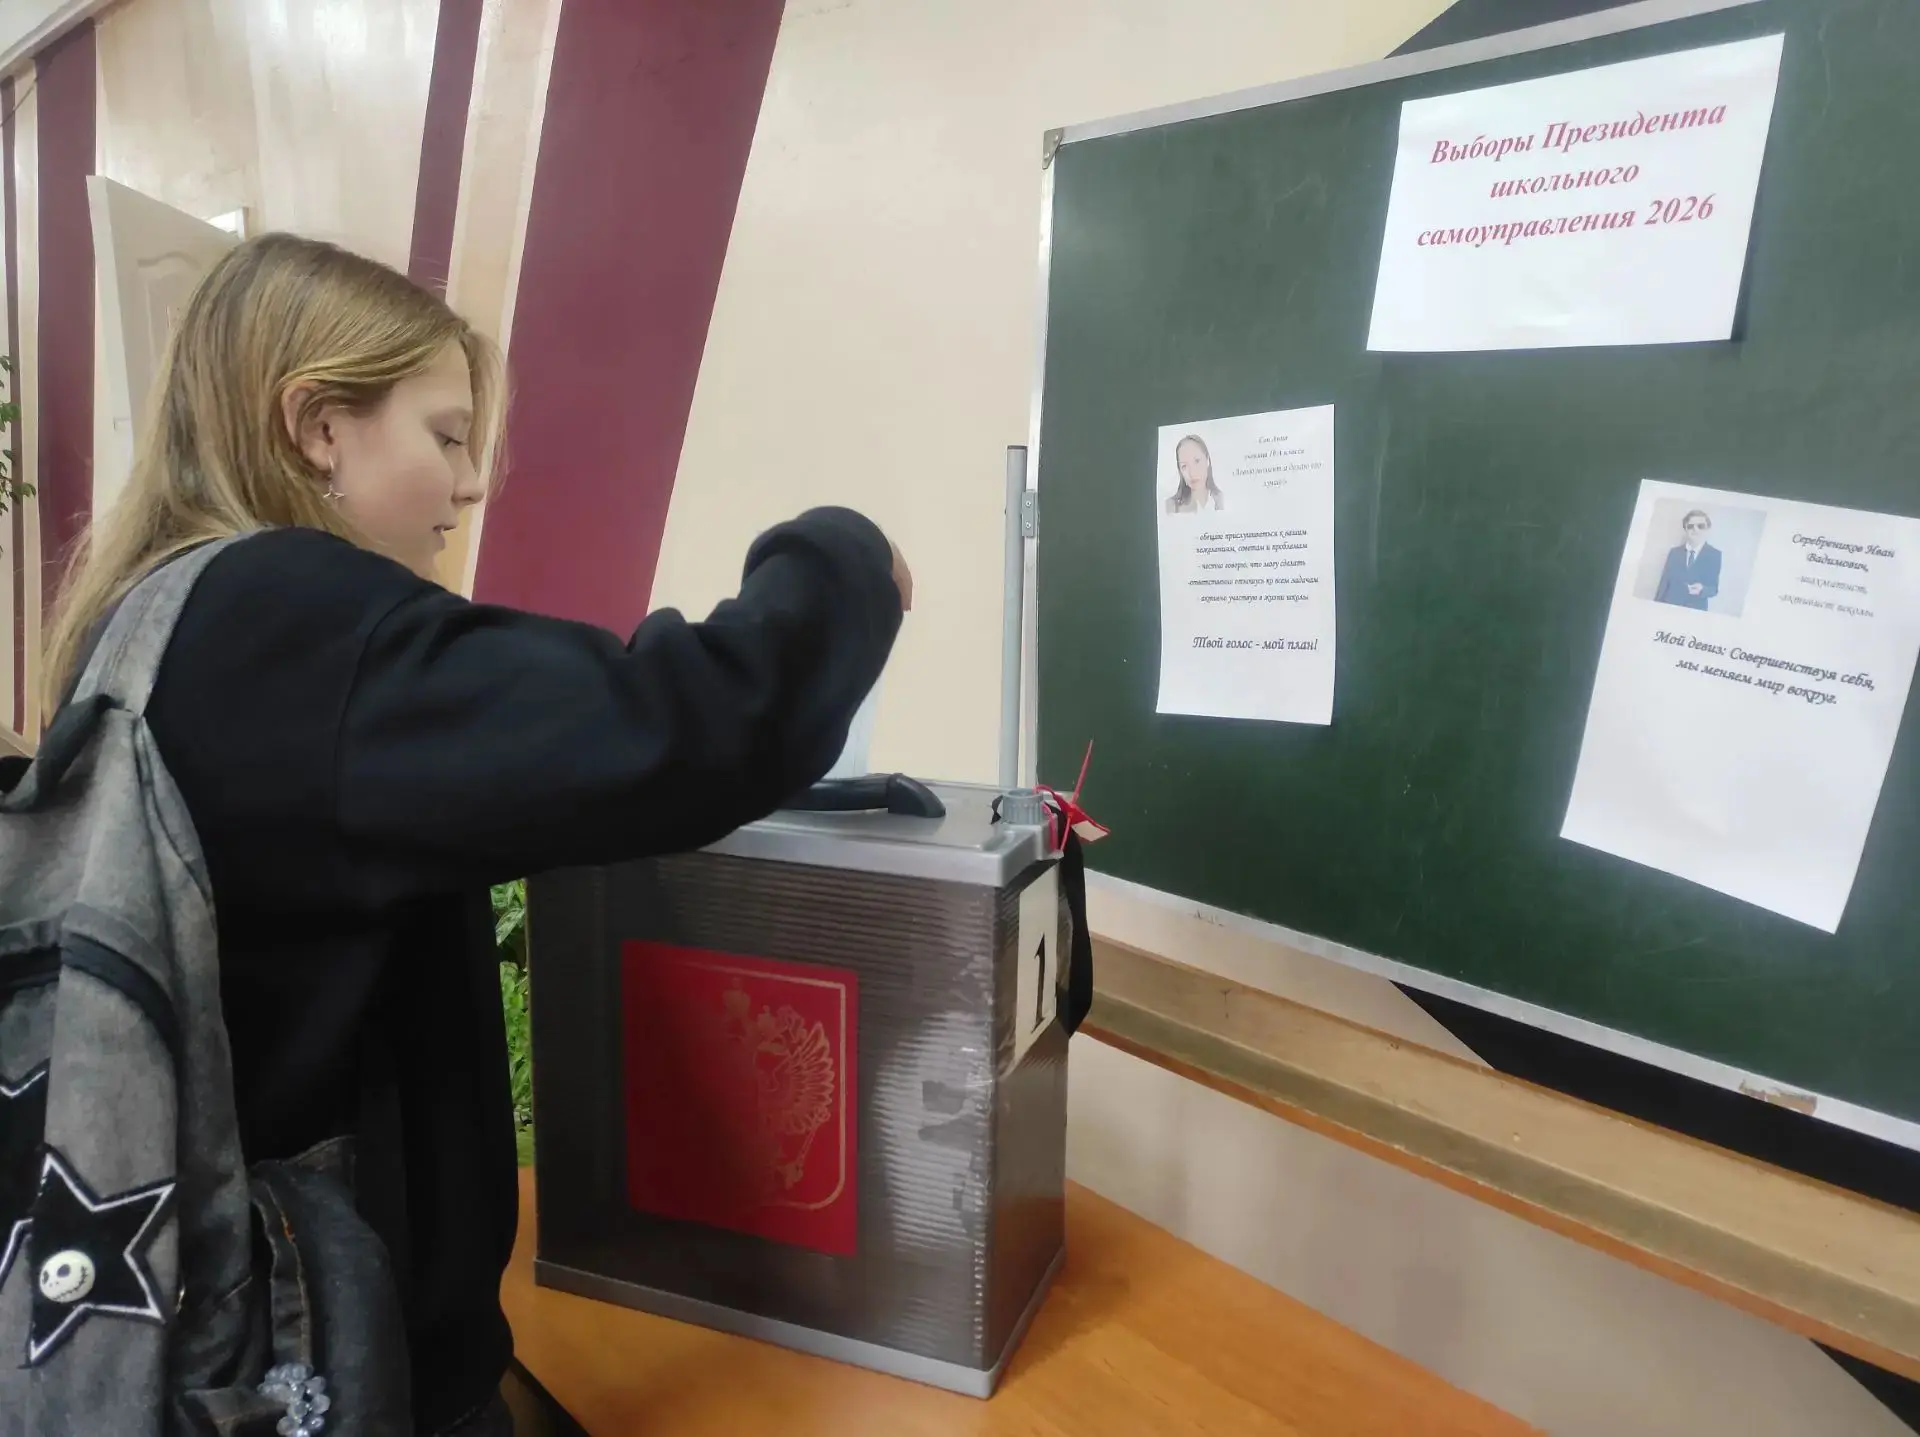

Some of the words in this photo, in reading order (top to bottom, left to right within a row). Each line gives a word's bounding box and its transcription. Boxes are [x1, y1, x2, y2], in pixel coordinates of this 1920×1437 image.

[1430, 135, 1534, 163] Выборы
[1542, 104, 1727, 153] Президента
[1490, 164, 1640, 198] школьного
[1417, 207, 1636, 248] самоуправления
[1644, 193, 1717, 226] 2026
[1200, 532, 1223, 540] обещаю
[1272, 541, 1307, 552] проблемам
[1792, 533, 1863, 554] Серебреников
[1865, 544, 1895, 558] Иван
[1263, 561, 1279, 570] могу
[1192, 636, 1223, 649] Твой
[1225, 639, 1253, 649] голос
[1262, 637, 1284, 650] мой
[1287, 638, 1319, 651] план!
[1653, 630, 1685, 646] Мой
[1687, 635, 1726, 656] девиз:
[1729, 647, 1837, 682] Совершенствуя
[1840, 672, 1875, 691] себя,
[1675, 658, 1699, 671] мы
[1701, 664, 1753, 684] меняем
[1755, 677, 1785, 695] мир
[1787, 684, 1838, 705] вокруг.
[1031, 932, 1046, 1034] 1
